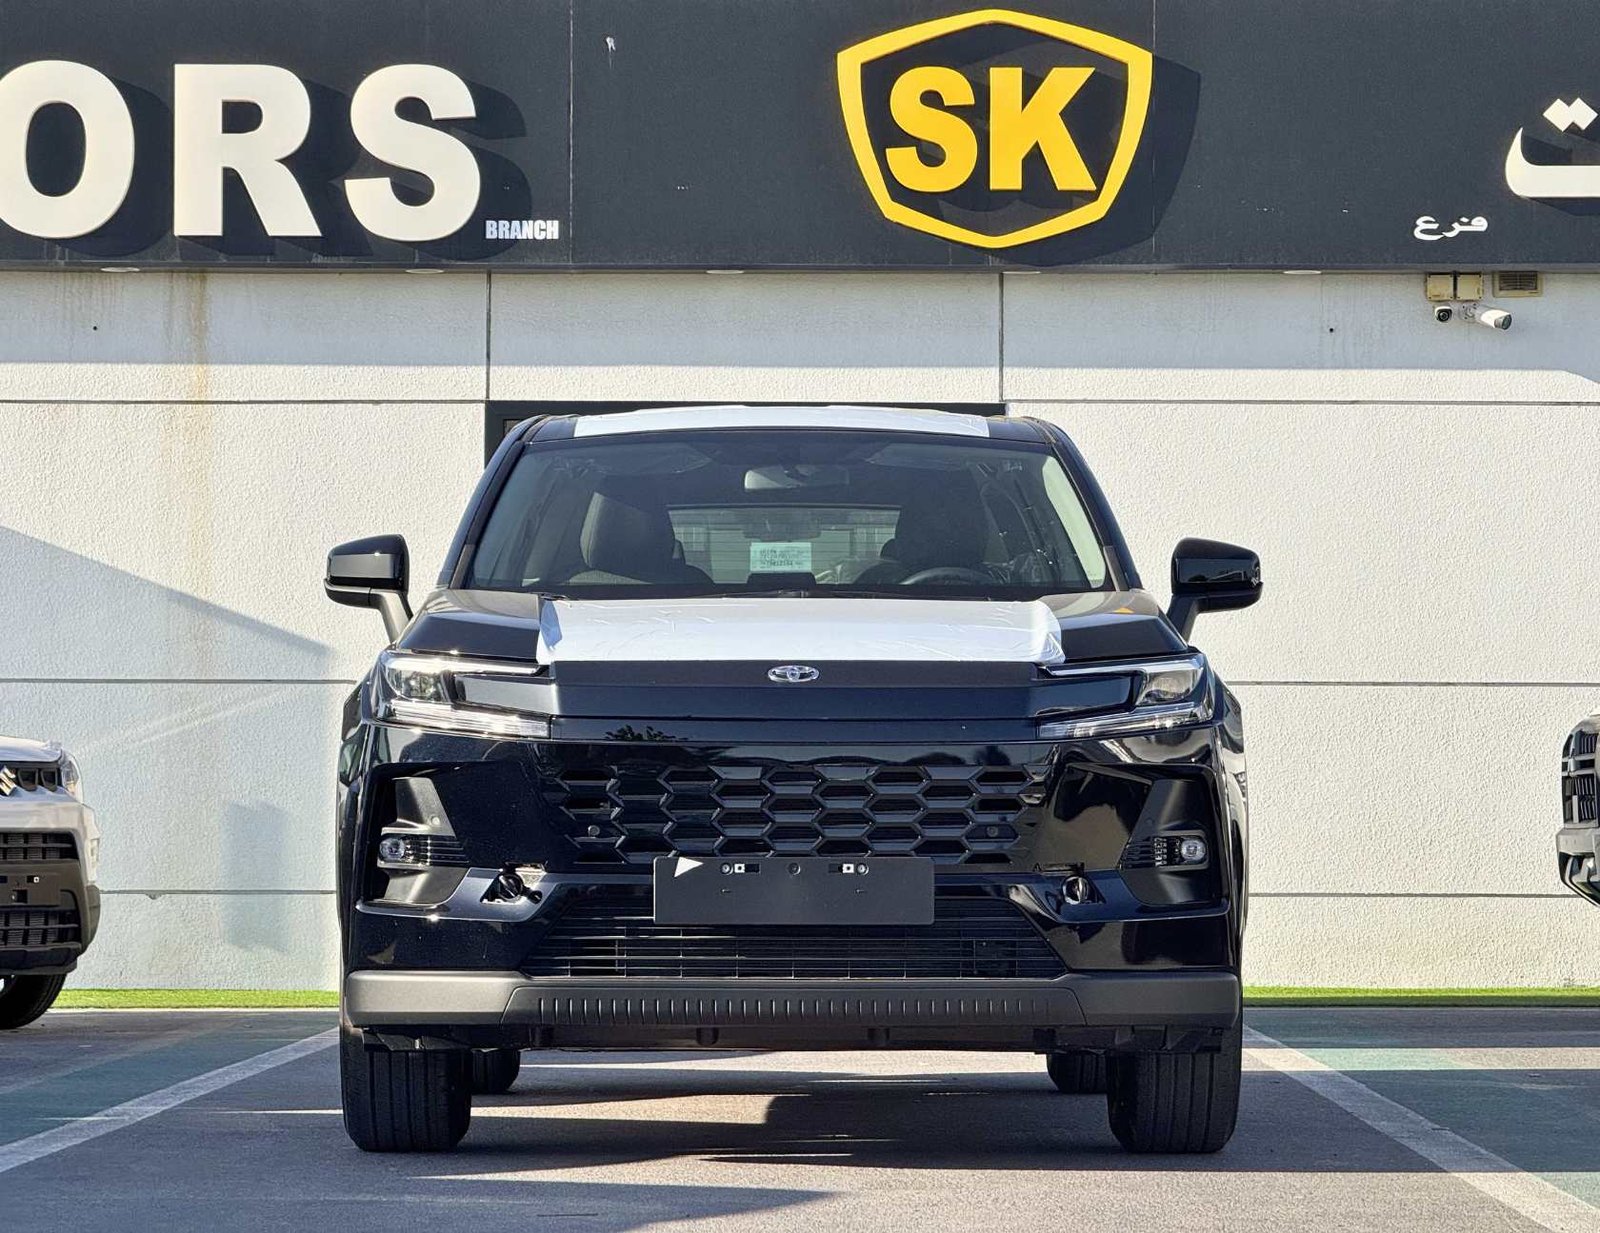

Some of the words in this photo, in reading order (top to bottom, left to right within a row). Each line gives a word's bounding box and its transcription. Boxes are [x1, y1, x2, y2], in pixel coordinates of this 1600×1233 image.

[0, 60, 481, 241] ORS
[885, 66, 1097, 192] SK
[485, 219, 560, 240] BRANCH
[1413, 215, 1489, 241] فرع
